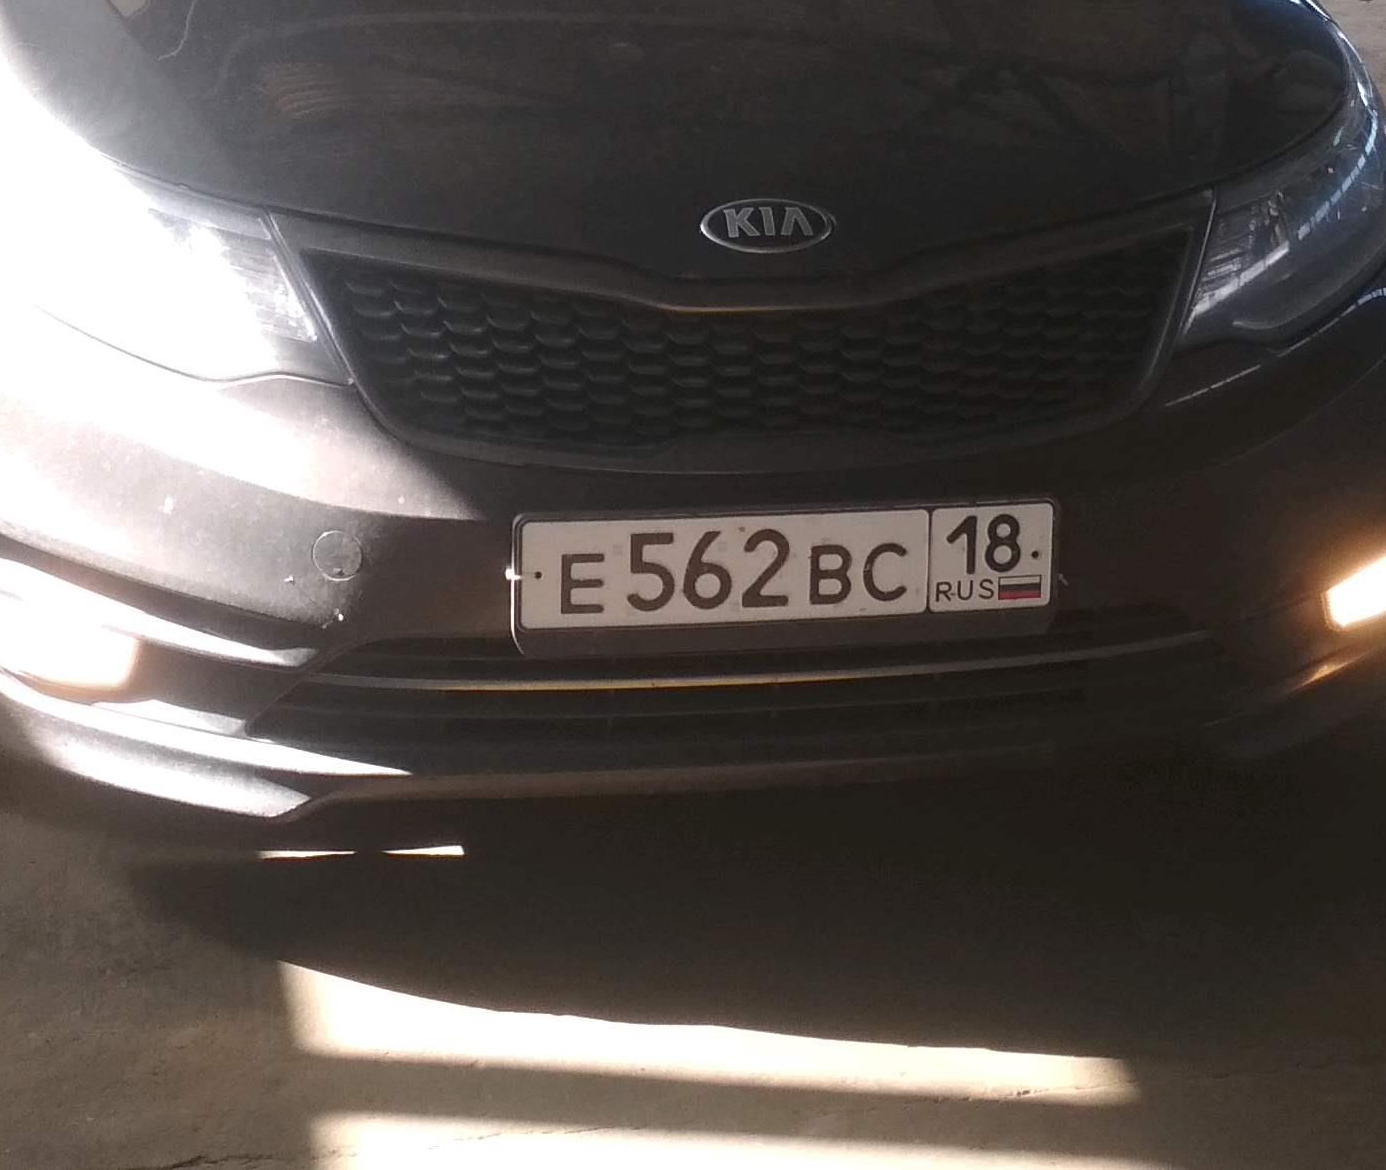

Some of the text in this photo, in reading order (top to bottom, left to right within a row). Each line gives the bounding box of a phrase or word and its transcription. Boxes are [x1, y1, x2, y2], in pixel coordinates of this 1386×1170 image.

[723, 206, 814, 238] KIA
[559, 513, 1022, 615] E562BC 18
[934, 578, 996, 603] RUS
